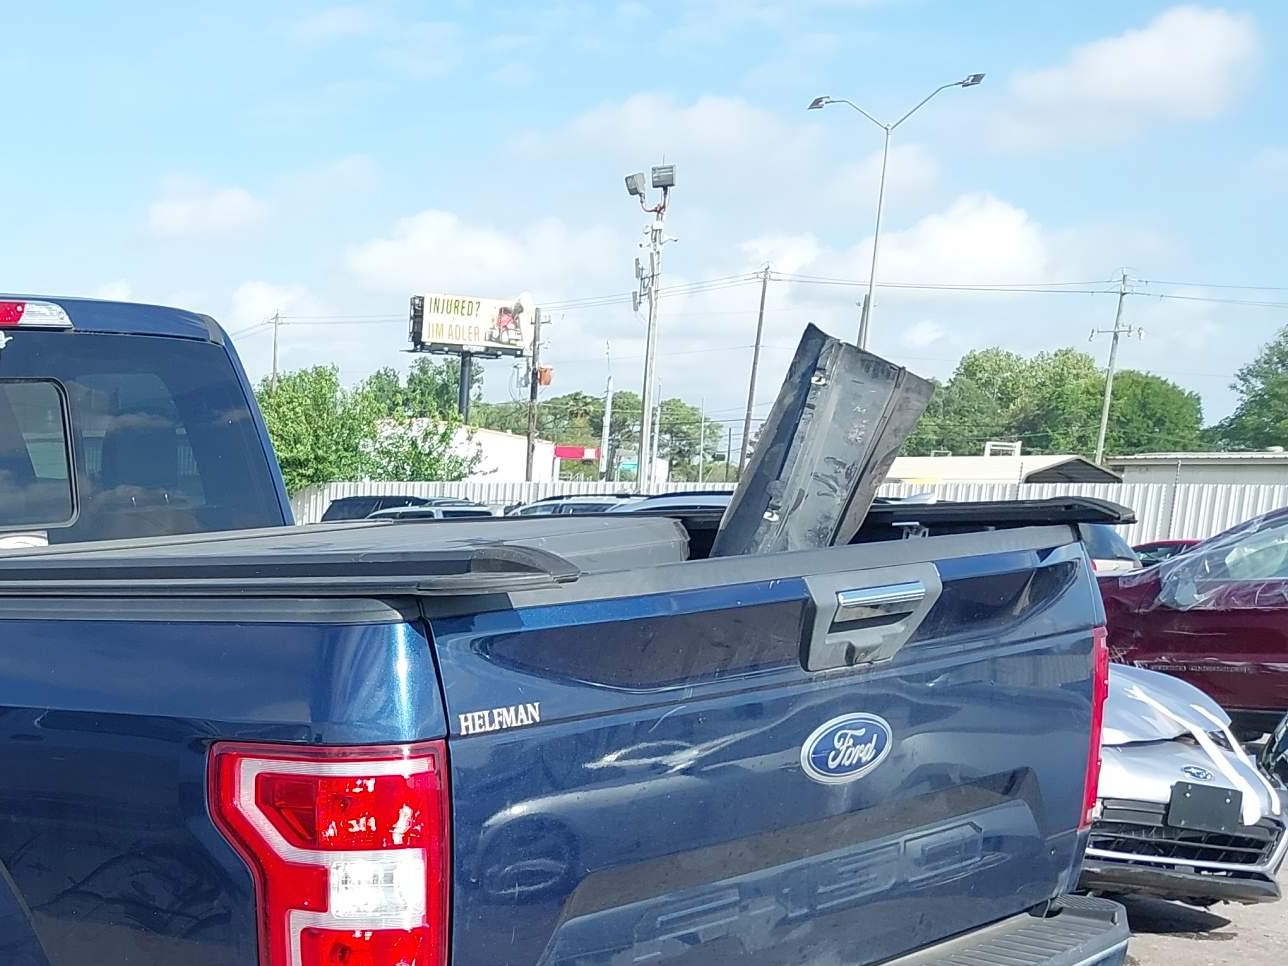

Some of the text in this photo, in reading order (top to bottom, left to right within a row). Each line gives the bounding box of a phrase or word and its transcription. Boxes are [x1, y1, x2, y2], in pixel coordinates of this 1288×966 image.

[429, 297, 481, 318] INJURED?
[426, 322, 480, 342] JIM ADLER
[458, 702, 541, 736] HELFMAN
[827, 729, 878, 770] Ford
